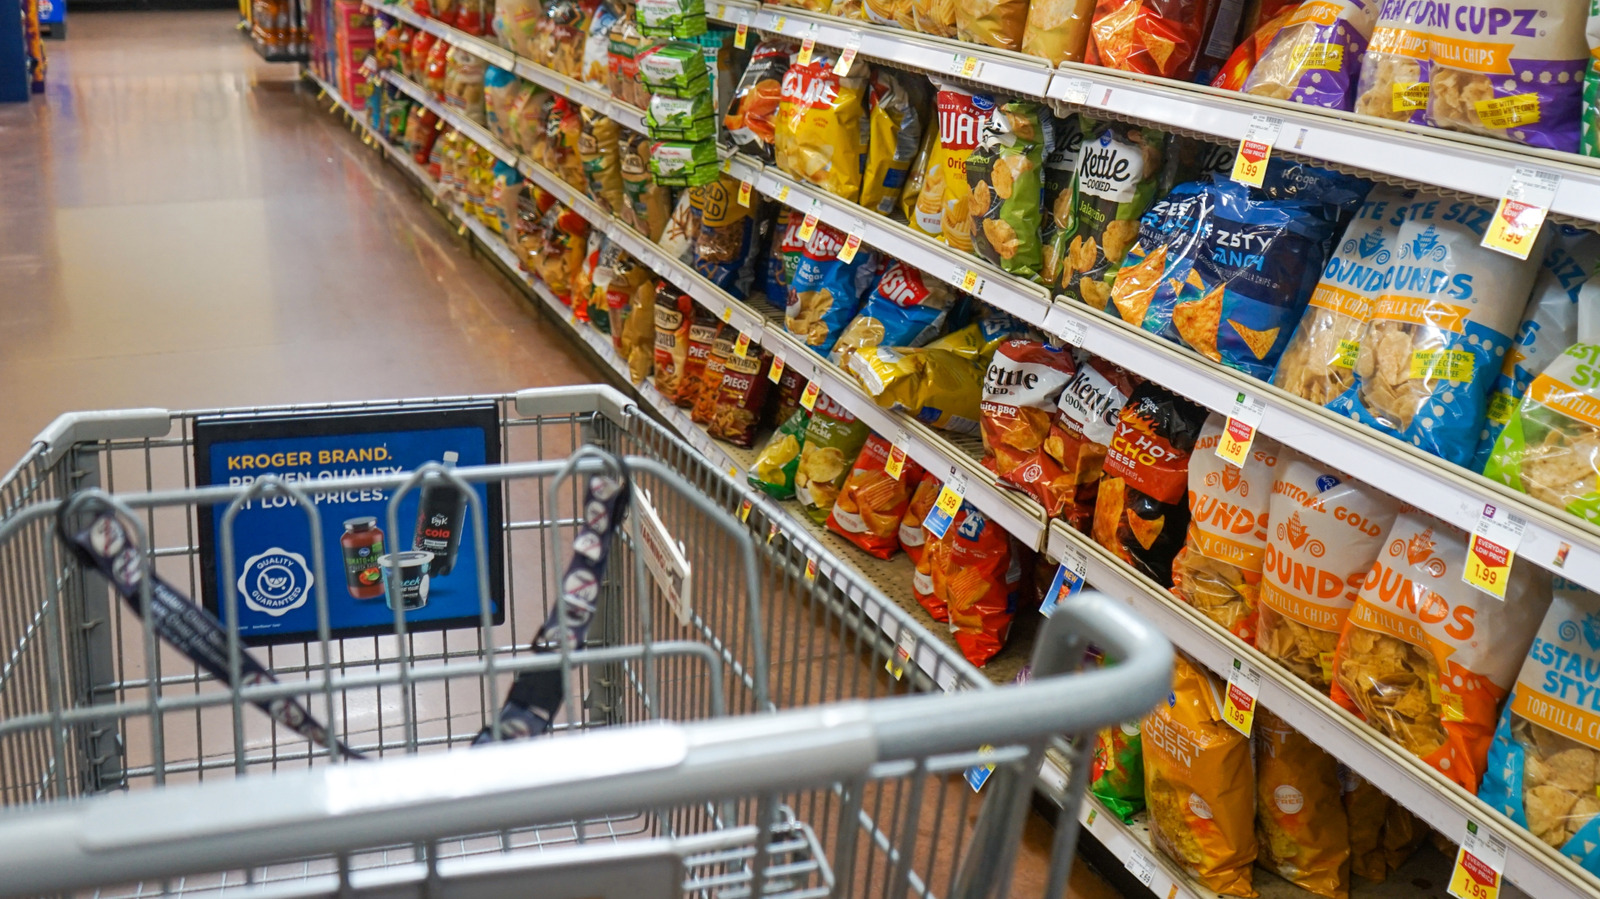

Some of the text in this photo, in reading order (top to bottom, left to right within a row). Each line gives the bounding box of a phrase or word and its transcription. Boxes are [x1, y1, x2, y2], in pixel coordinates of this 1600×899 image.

[1455, 5, 1538, 38] CUPZ
[1463, 47, 1494, 66] CHIPS
[1245, 142, 1267, 151] EVERYDAY
[1252, 150, 1266, 158] PRICE
[1080, 146, 1131, 182] Kettle
[1240, 162, 1258, 177] 1.99
[1383, 265, 1475, 300] OUNDS
[1446, 352, 1470, 363] 100%
[986, 363, 1039, 390] ettle
[1071, 371, 1121, 427] Kettle
[1548, 385, 1600, 420] TORTILLA
[997, 405, 1017, 417] BBQ
[1229, 426, 1250, 439] LOW PRICE
[1231, 419, 1251, 433] EVERYDAY
[1135, 436, 1178, 462] HOT
[1226, 440, 1242, 456] 1.99
[228, 446, 393, 471] KROGER BRAND.
[1125, 468, 1138, 480] CHIPS
[314, 487, 389, 506] PRICES.
[941, 493, 957, 509] 1.99
[1485, 506, 1495, 516] GF
[1333, 506, 1381, 537] GOLD
[424, 528, 451, 539] cola
[1214, 540, 1245, 561] CHIPS
[1475, 546, 1506, 565] LOW PRICE
[1477, 538, 1507, 556] EVERYDAY
[256, 557, 295, 570] QUALITY
[1265, 542, 1367, 602] OUNDS
[1063, 569, 1079, 584] NEW
[1475, 563, 1497, 585] 1.99
[251, 586, 302, 607] GUARANTEED
[1364, 560, 1478, 641] OUNDS
[1303, 606, 1338, 626] CHIPS
[1355, 603, 1405, 634] TORTILLA
[1229, 691, 1251, 710] LOW PRICE
[1231, 685, 1251, 702] EVERYDAY
[1230, 706, 1245, 725] 1.99
[1526, 695, 1584, 734] TORTILLA
[1170, 718, 1212, 747] STYLE
[1145, 719, 1191, 768] CORN
[1464, 861, 1494, 885] LOW PRICE
[1465, 853, 1494, 877] EVERYDAY
[1464, 878, 1487, 899] 1.99
